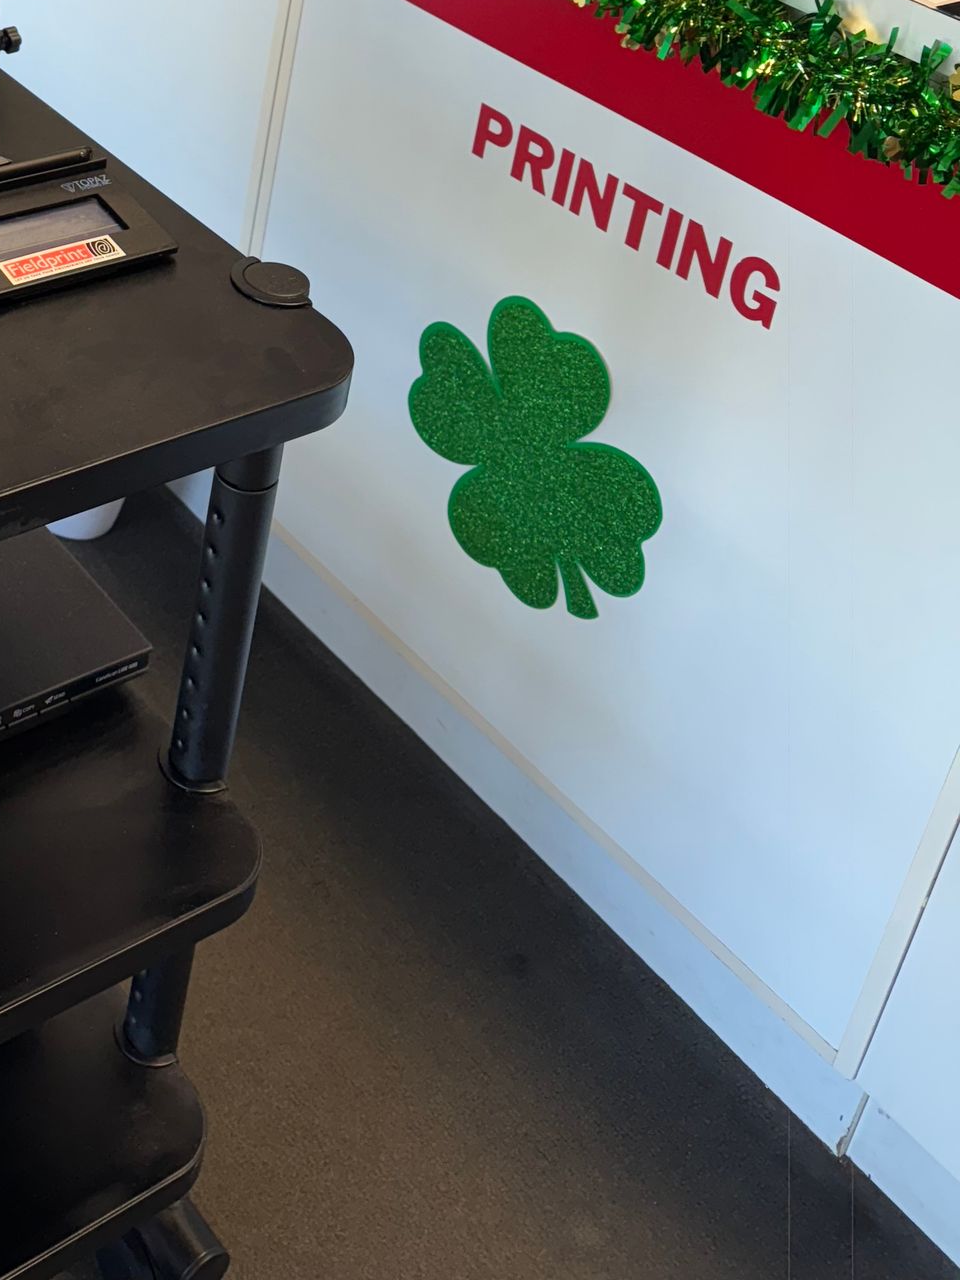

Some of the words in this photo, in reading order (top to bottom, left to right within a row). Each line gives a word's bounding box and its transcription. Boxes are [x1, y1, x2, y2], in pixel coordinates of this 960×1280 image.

[73, 174, 109, 189] TOPAZ
[471, 102, 781, 330] PRINTING
[6, 248, 87, 277] Fieldprint
